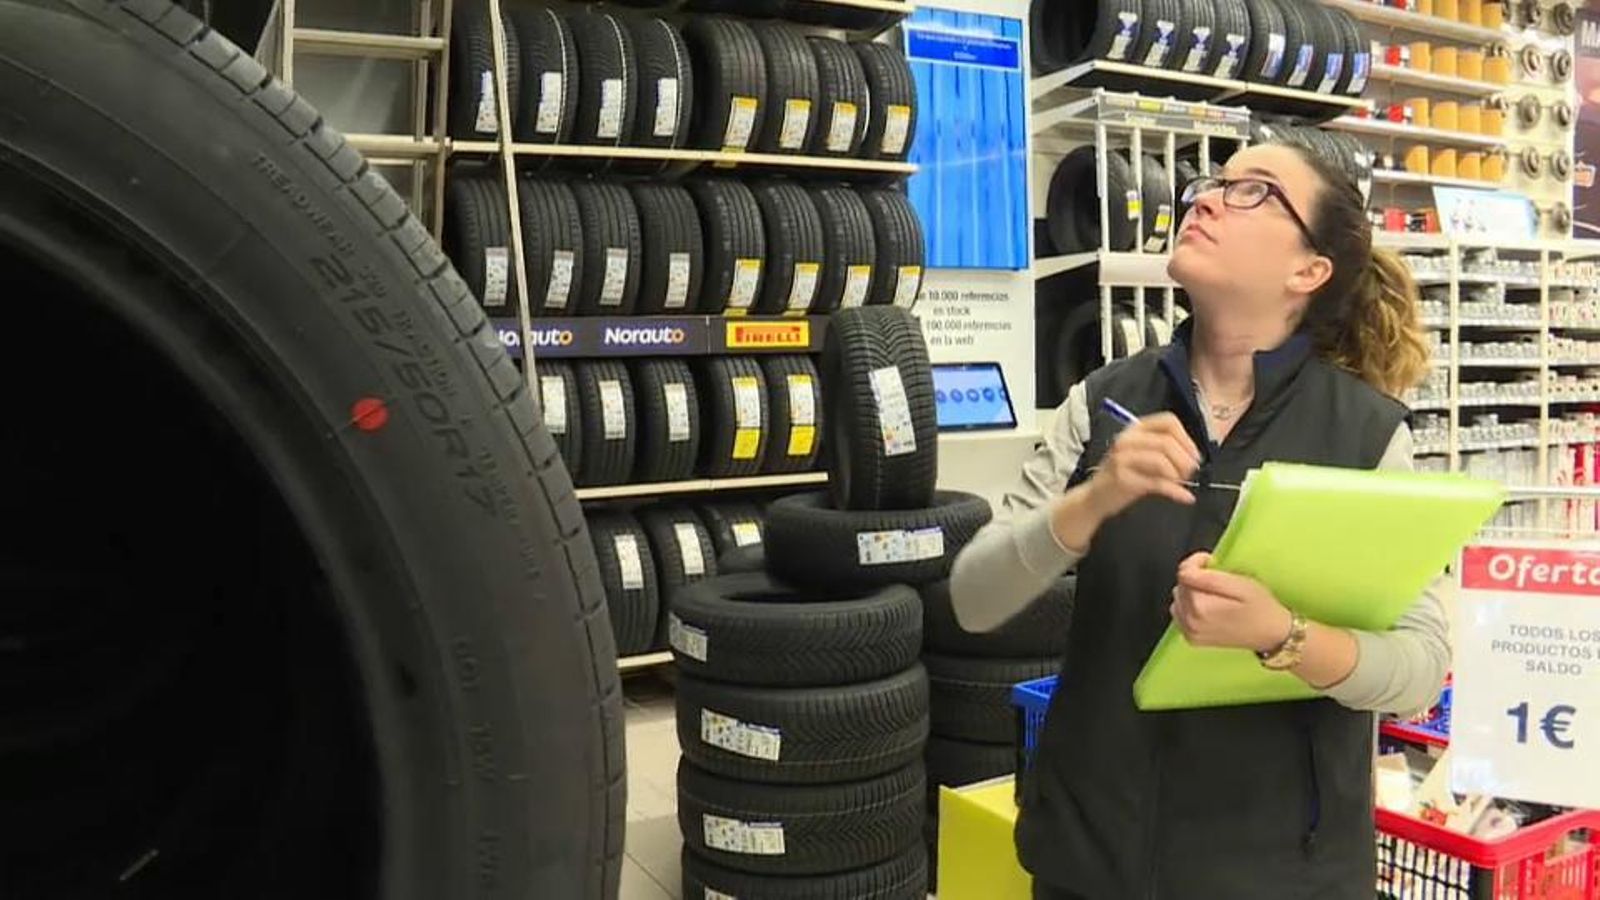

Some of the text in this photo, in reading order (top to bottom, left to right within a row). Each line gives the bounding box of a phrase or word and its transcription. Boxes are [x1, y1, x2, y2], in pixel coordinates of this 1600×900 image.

[604, 326, 685, 345] Norauto
[1510, 624, 1564, 641] TODOS
[1491, 640, 1592, 660] PRODUCTOS
[1525, 660, 1582, 676] SALDO
[1507, 702, 1577, 749] 1€
